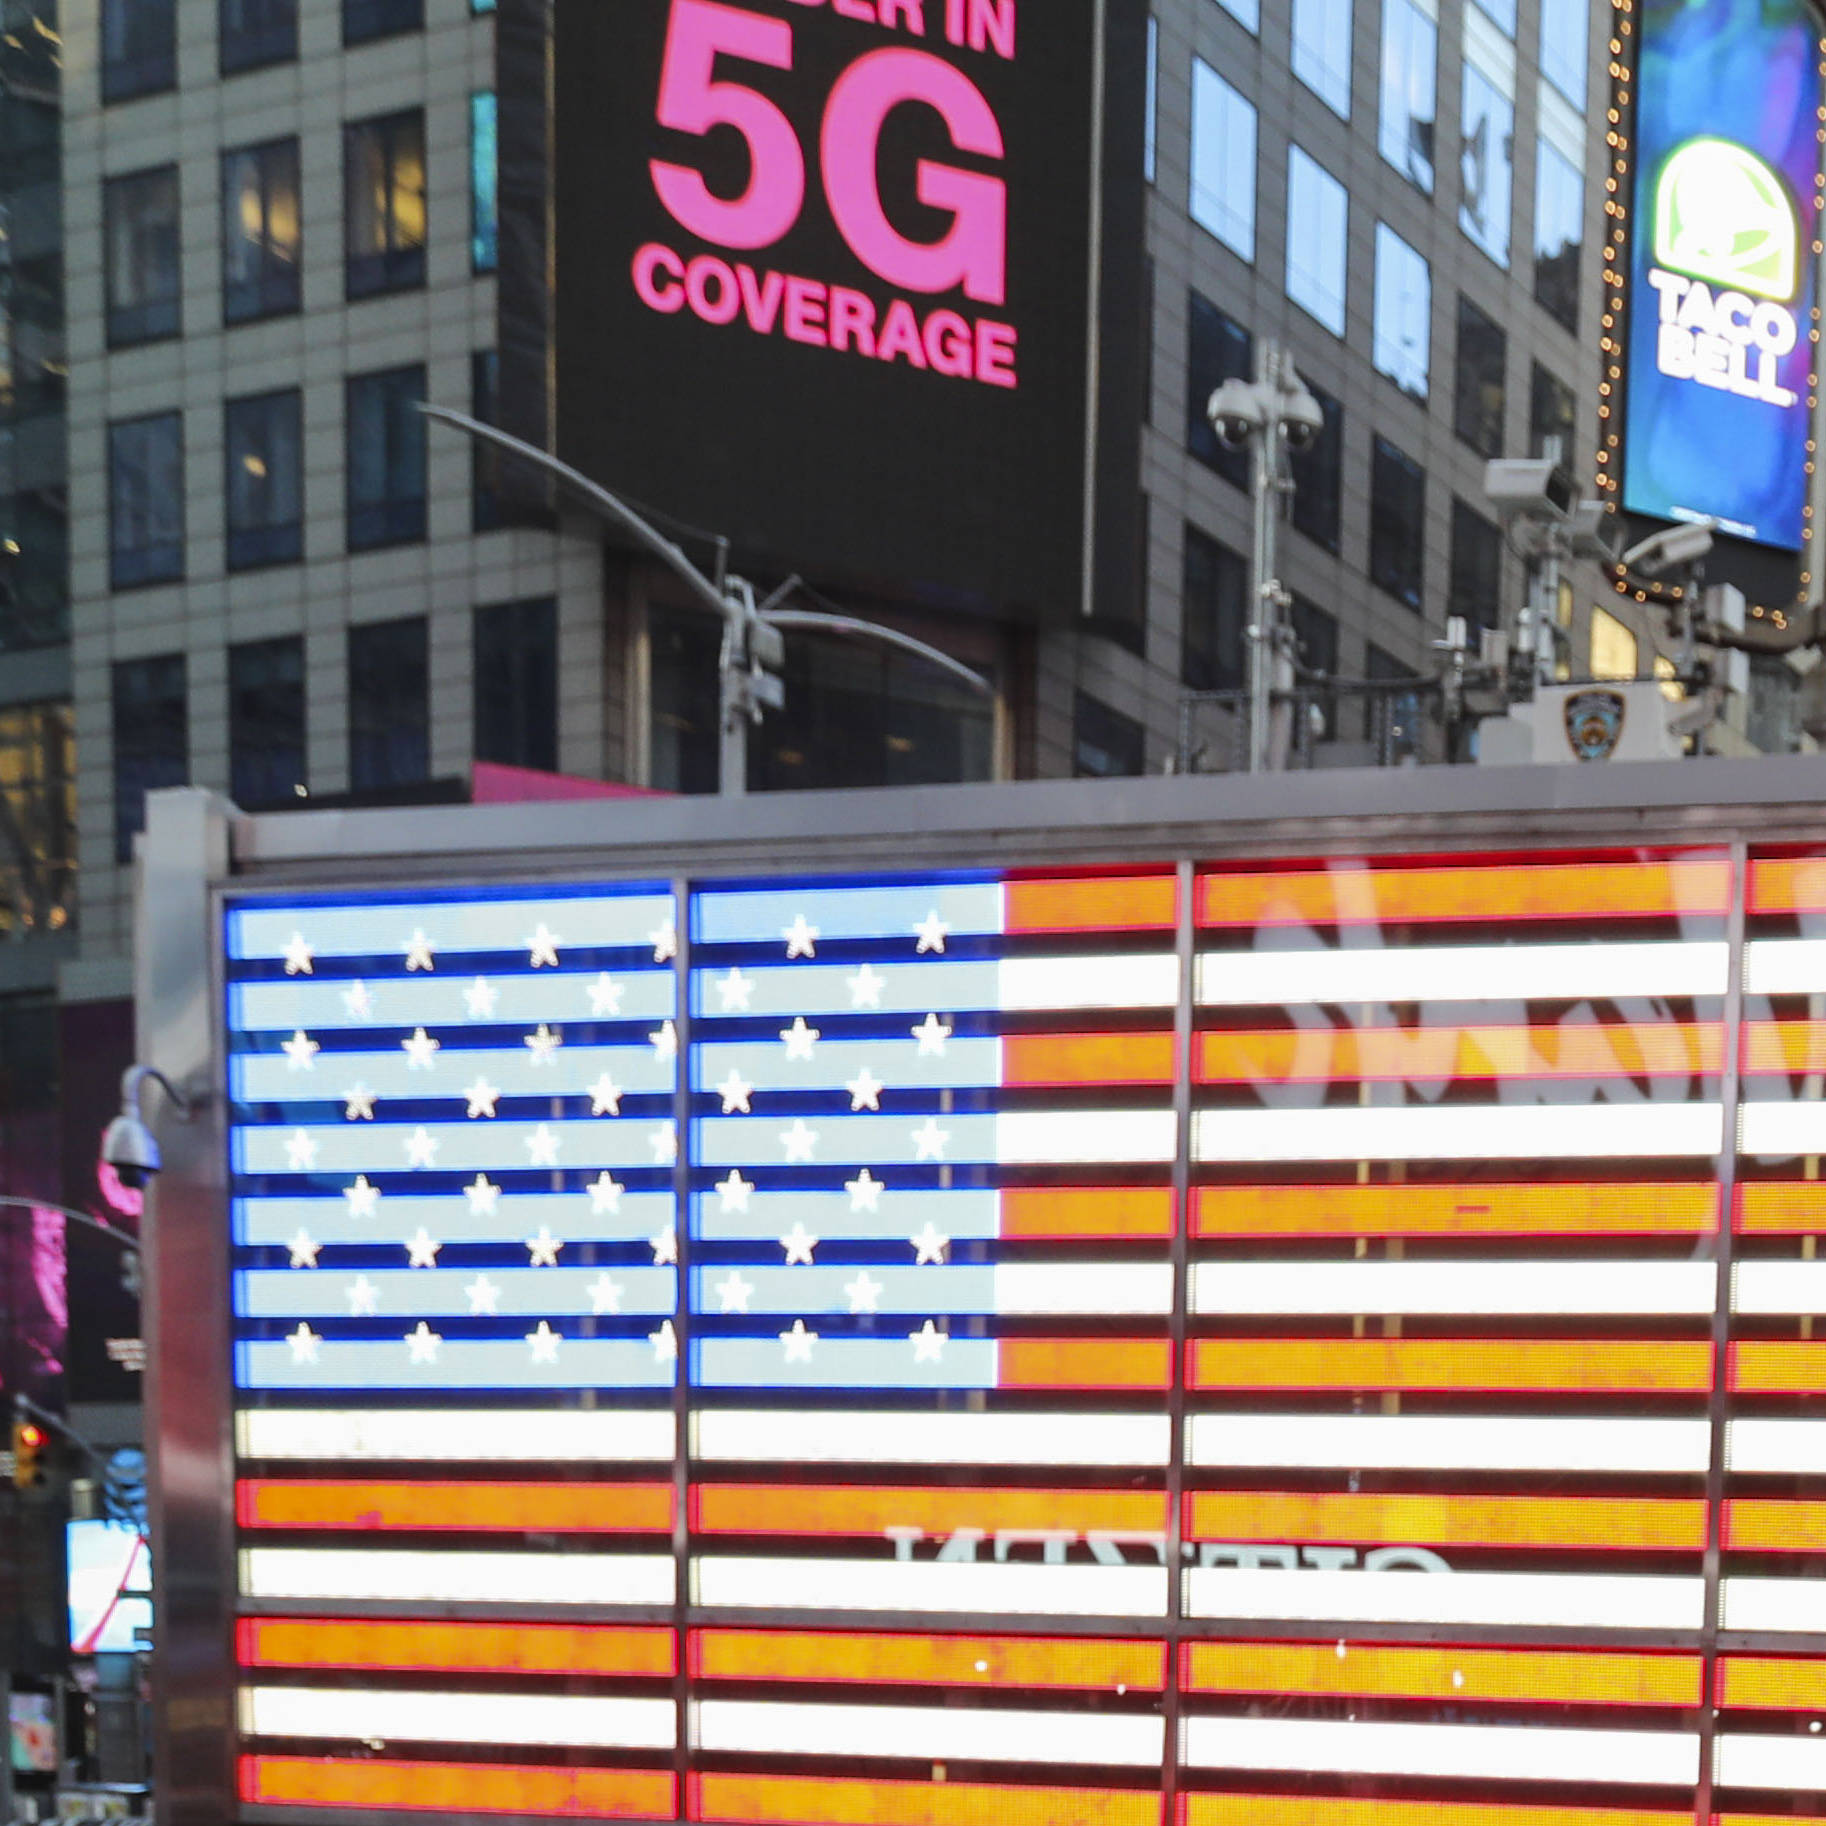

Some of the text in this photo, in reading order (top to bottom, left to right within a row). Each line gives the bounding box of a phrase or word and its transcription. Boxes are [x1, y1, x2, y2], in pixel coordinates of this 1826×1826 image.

[649, 0, 1006, 306] 5G
[631, 242, 1018, 389] COVERAGE
[1648, 267, 1798, 356] TACO
[1657, 322, 1799, 408] BELL
